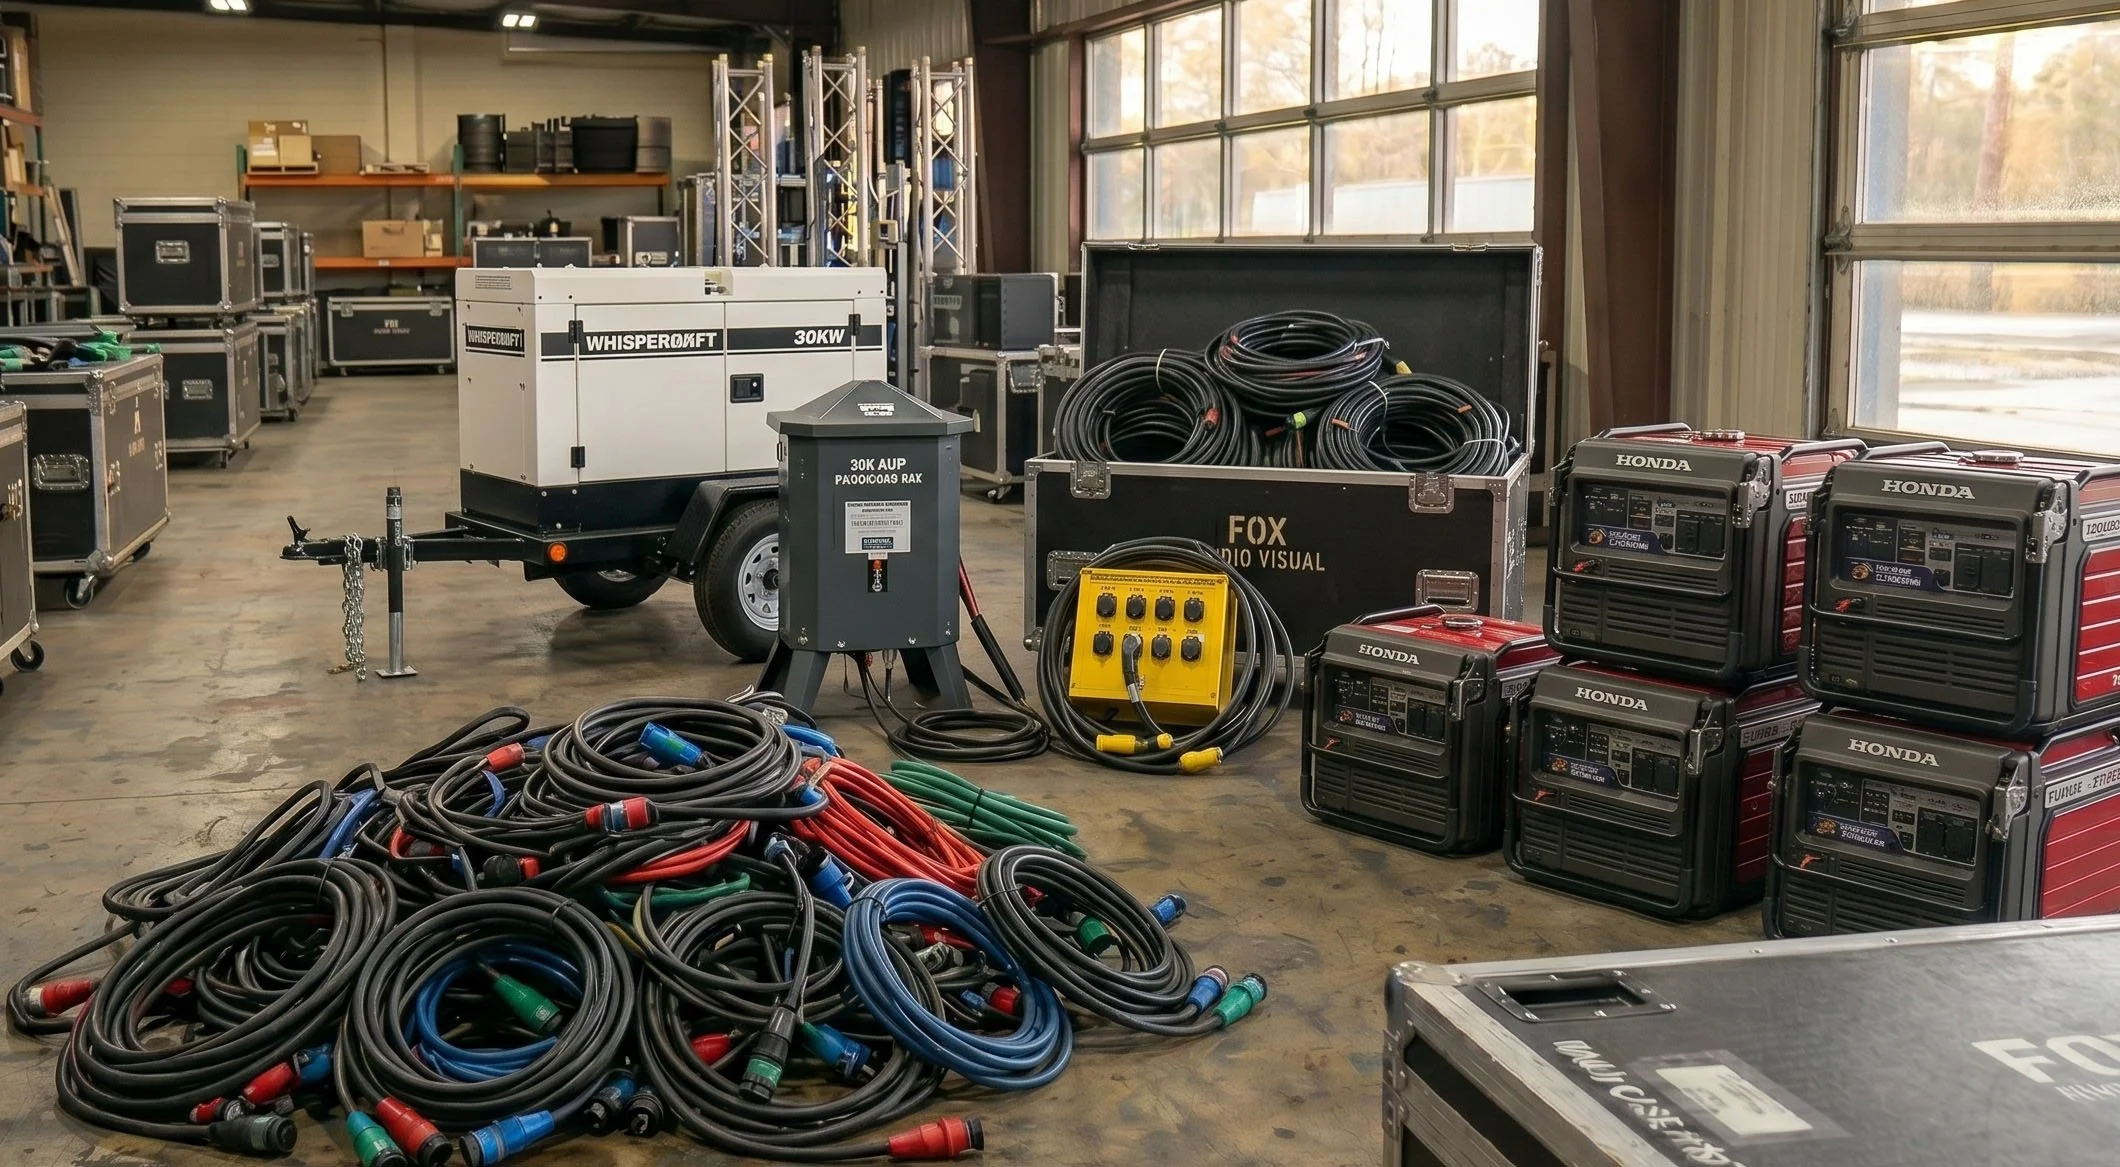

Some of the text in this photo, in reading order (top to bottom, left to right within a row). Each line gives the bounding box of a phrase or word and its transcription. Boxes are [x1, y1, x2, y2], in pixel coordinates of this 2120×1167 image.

[794, 329, 845, 345] 30KW
[850, 457, 907, 471] 30K AUP
[1616, 454, 1692, 472] HONDA
[901, 472, 923, 484] RAX
[1881, 479, 1975, 499] HONDA
[1228, 515, 1287, 546] FOX
[1259, 549, 1325, 571] VISUAL
[1574, 687, 1648, 711] HONDA
[1847, 739, 1940, 767] HONDA
[1971, 1034, 2120, 1083] FO
